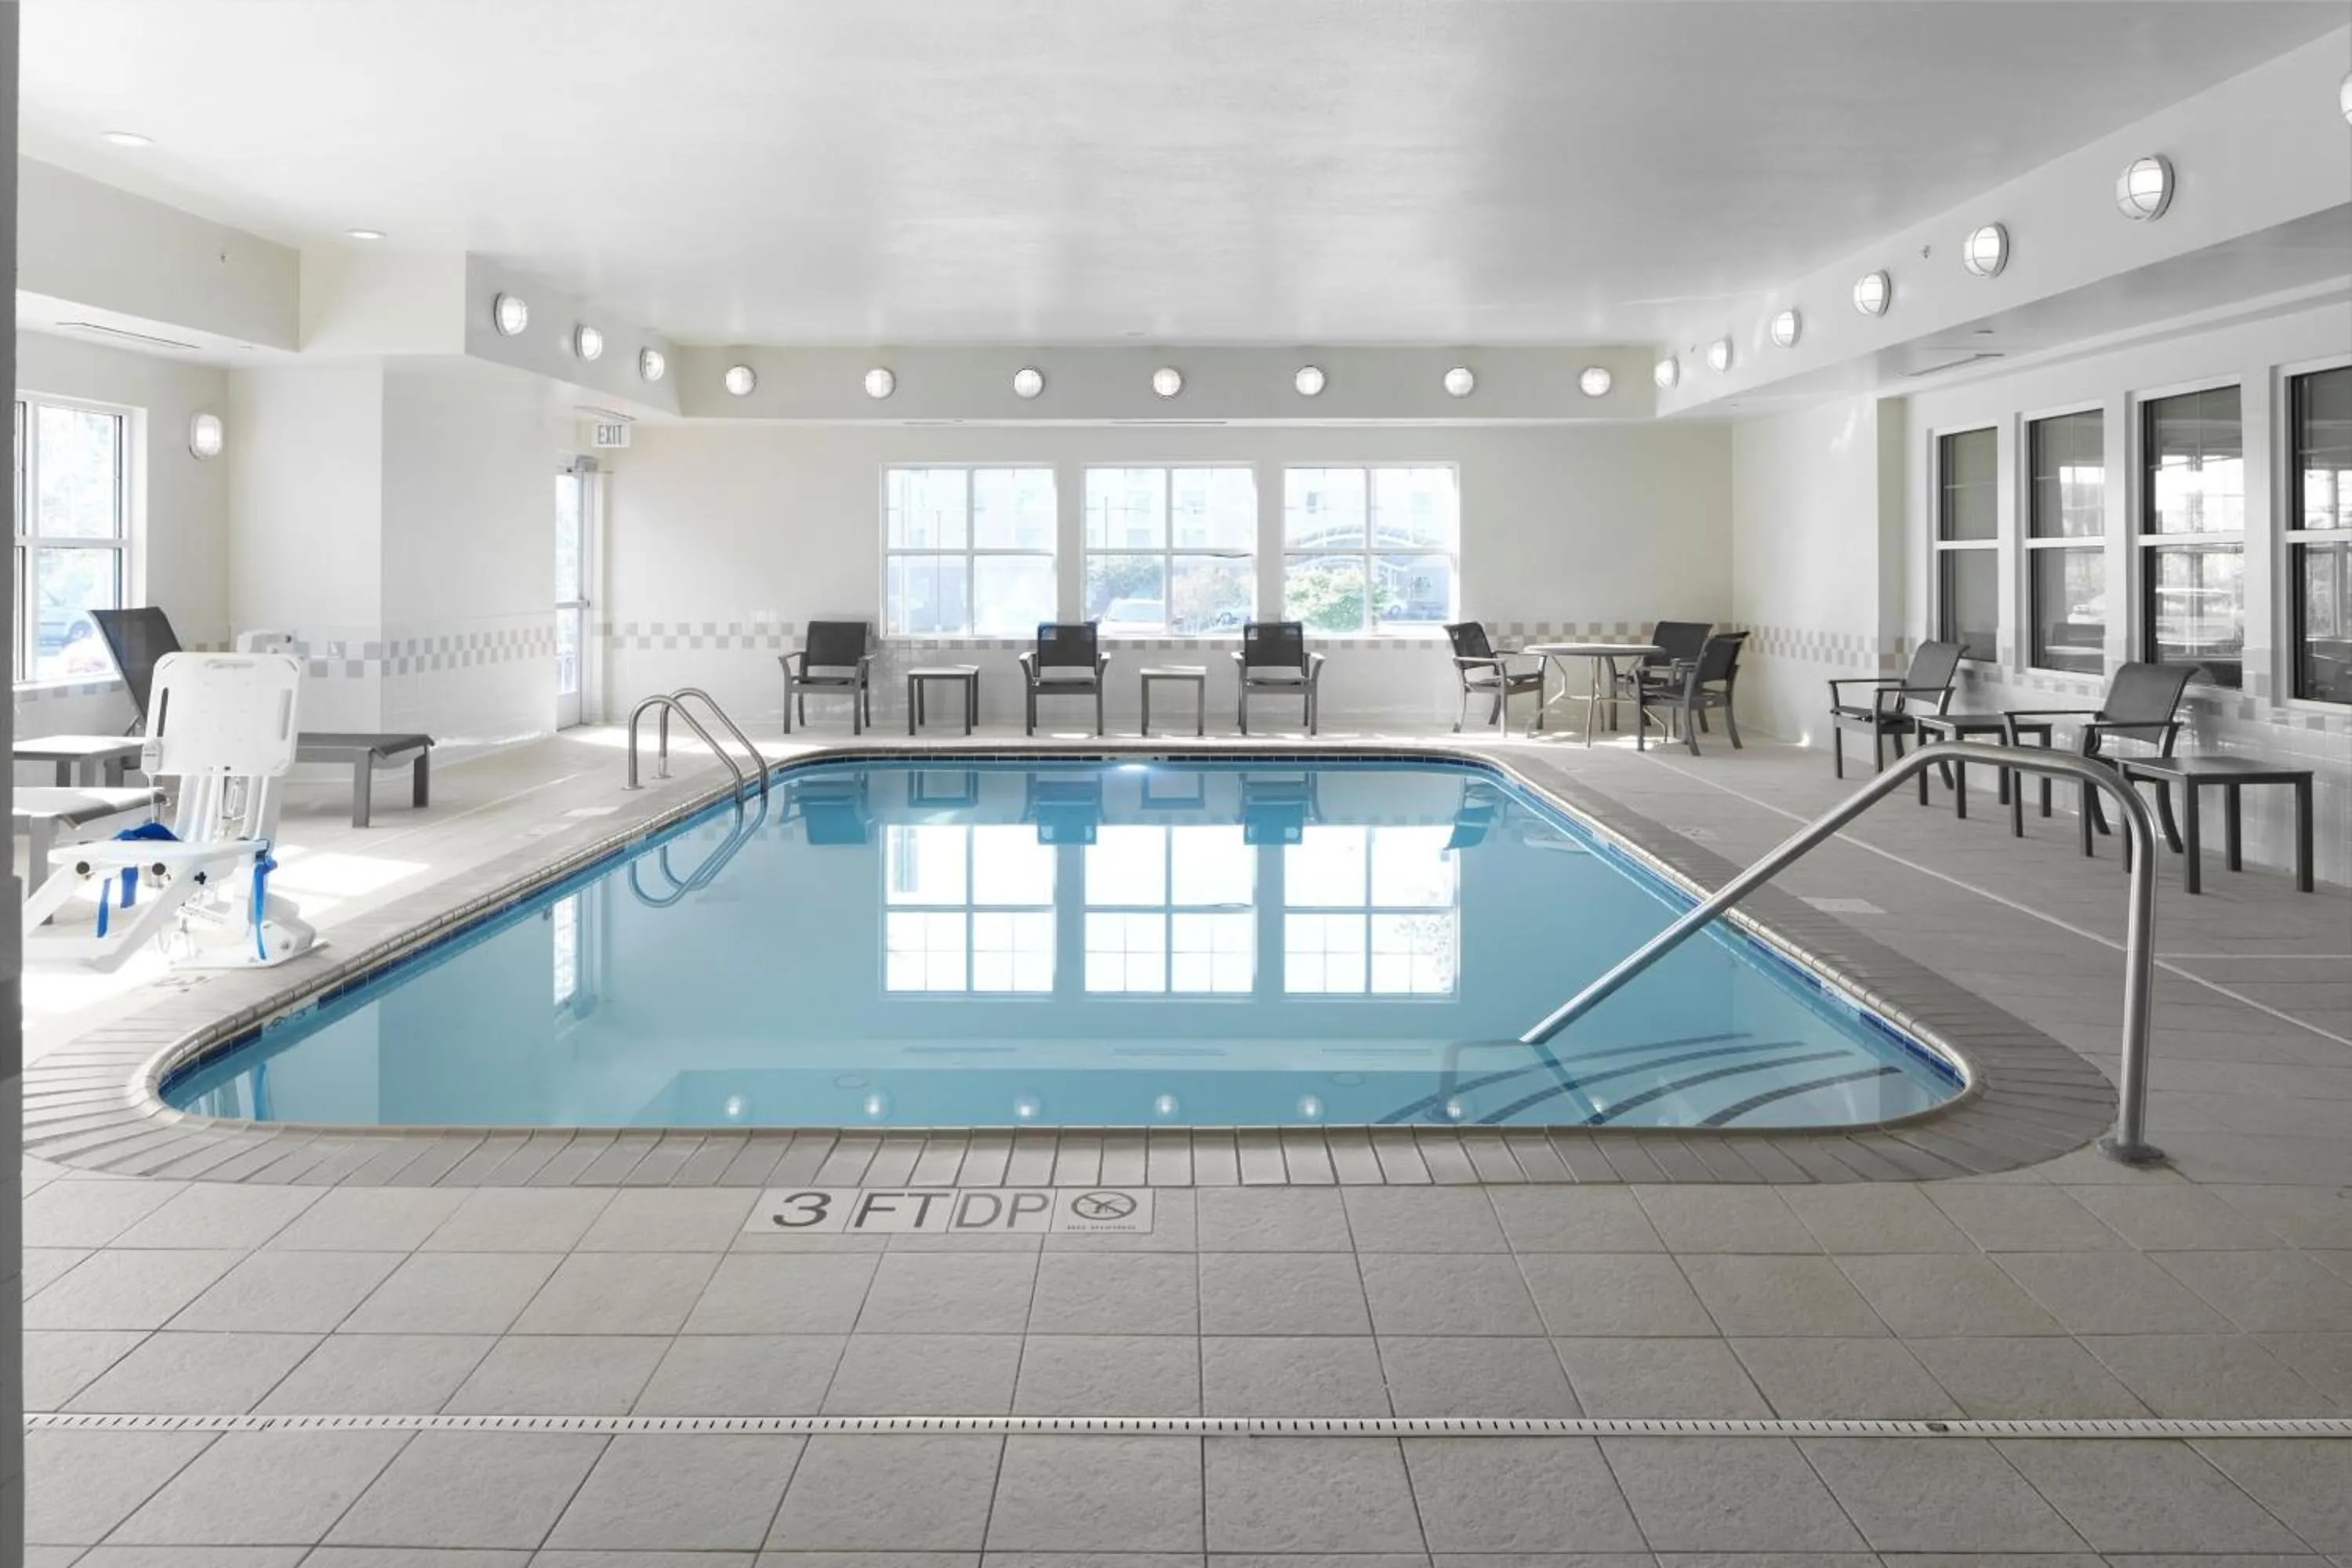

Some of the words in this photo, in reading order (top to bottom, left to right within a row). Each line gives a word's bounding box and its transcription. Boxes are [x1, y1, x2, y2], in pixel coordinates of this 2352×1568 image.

[597, 424, 622, 445] EXIT
[772, 1192, 832, 1228] 3
[854, 1192, 950, 1229] FT
[955, 1192, 1050, 1229] DP
